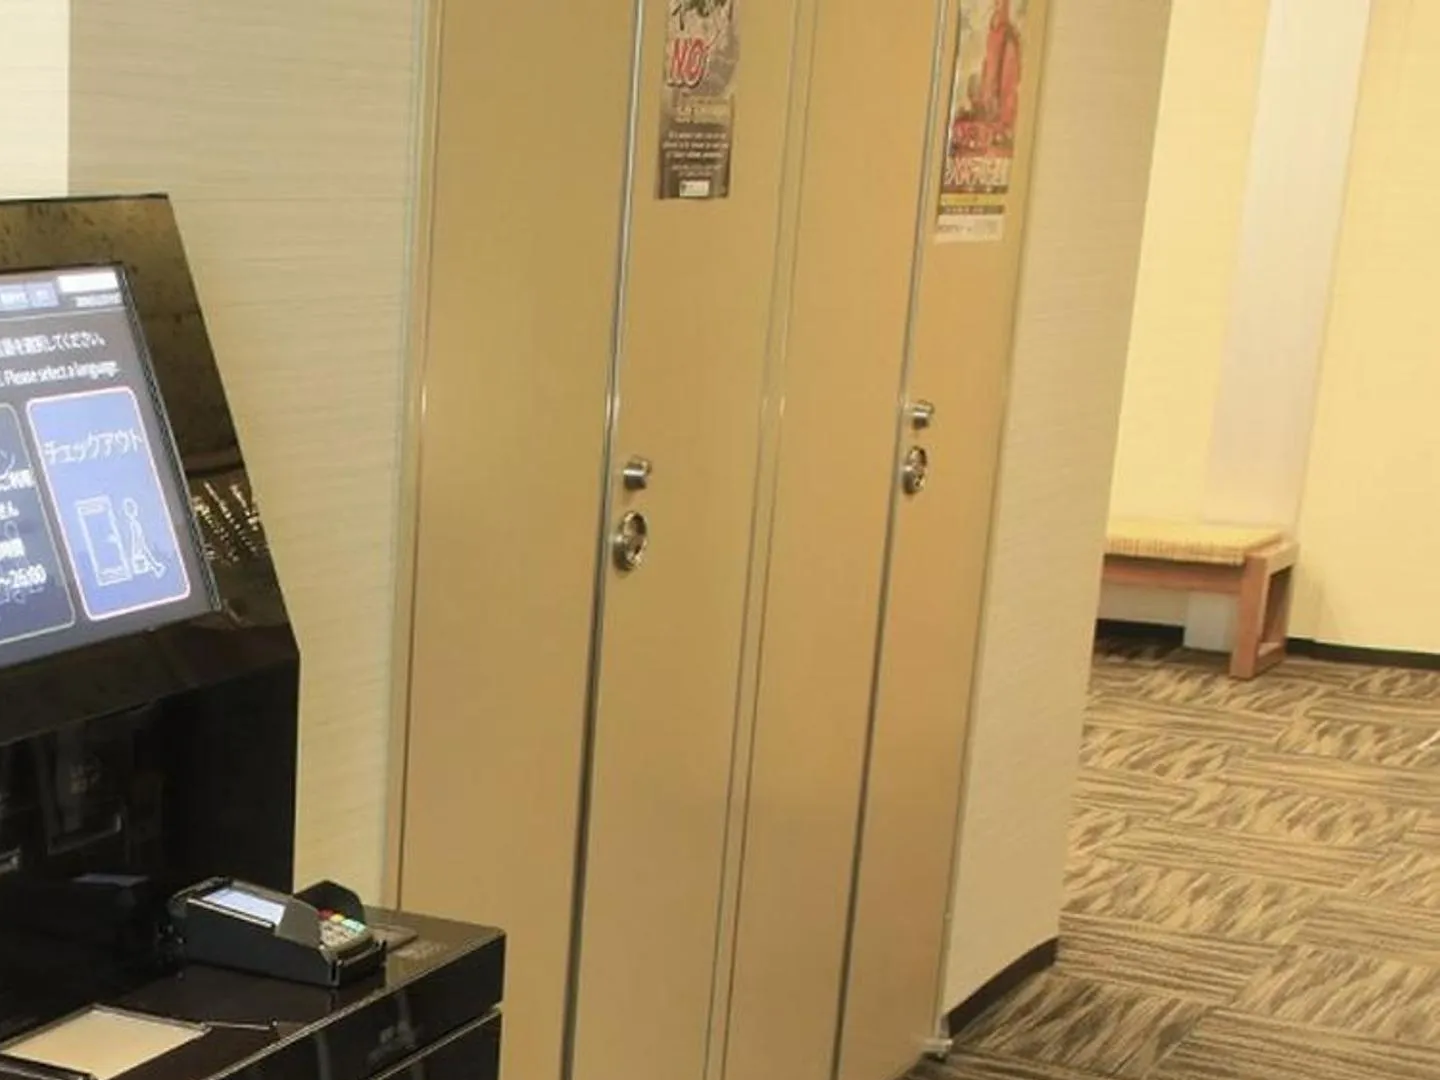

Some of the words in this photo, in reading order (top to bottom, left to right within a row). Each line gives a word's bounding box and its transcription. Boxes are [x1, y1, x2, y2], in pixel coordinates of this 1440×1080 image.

[3, 366, 38, 386] Please
[37, 364, 67, 381] select
[43, 429, 144, 465] チェックアウト
